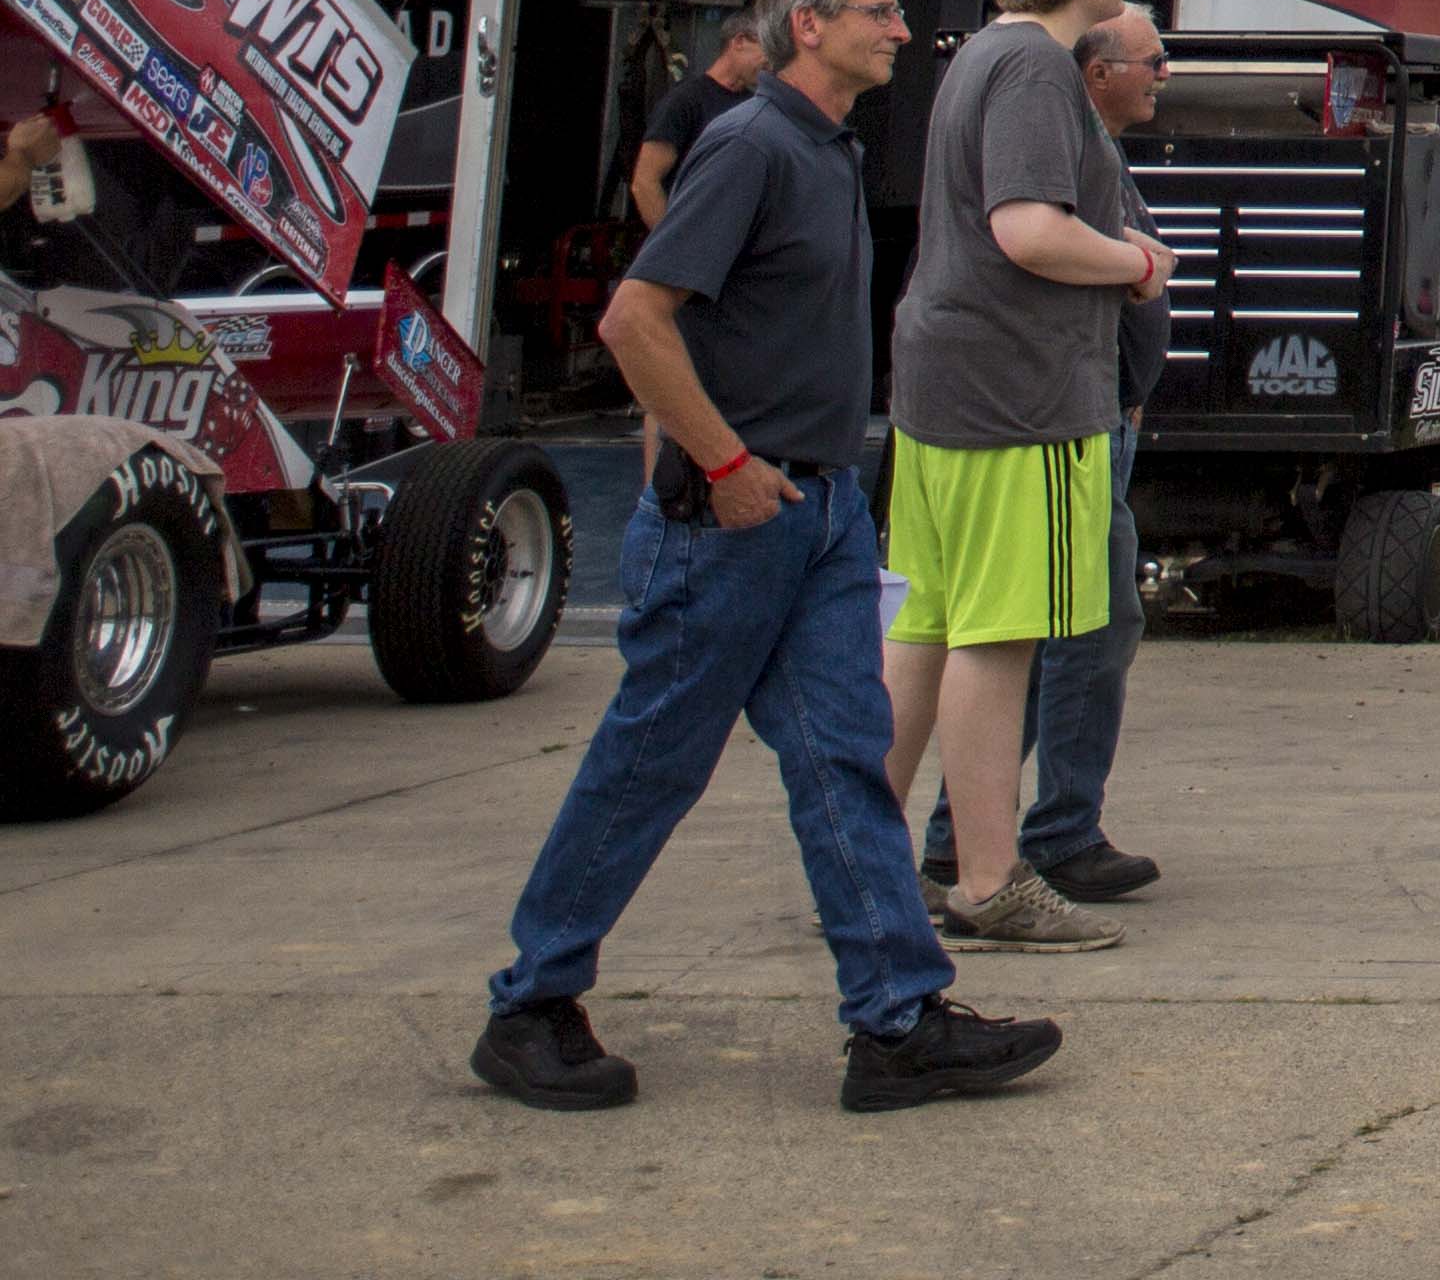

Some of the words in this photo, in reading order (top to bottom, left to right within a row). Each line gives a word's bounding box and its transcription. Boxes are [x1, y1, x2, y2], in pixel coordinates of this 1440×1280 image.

[147, 57, 192, 113] sears
[126, 84, 174, 134] MSD
[1248, 334, 1338, 378] MAC
[1247, 378, 1338, 396] TOOLS
